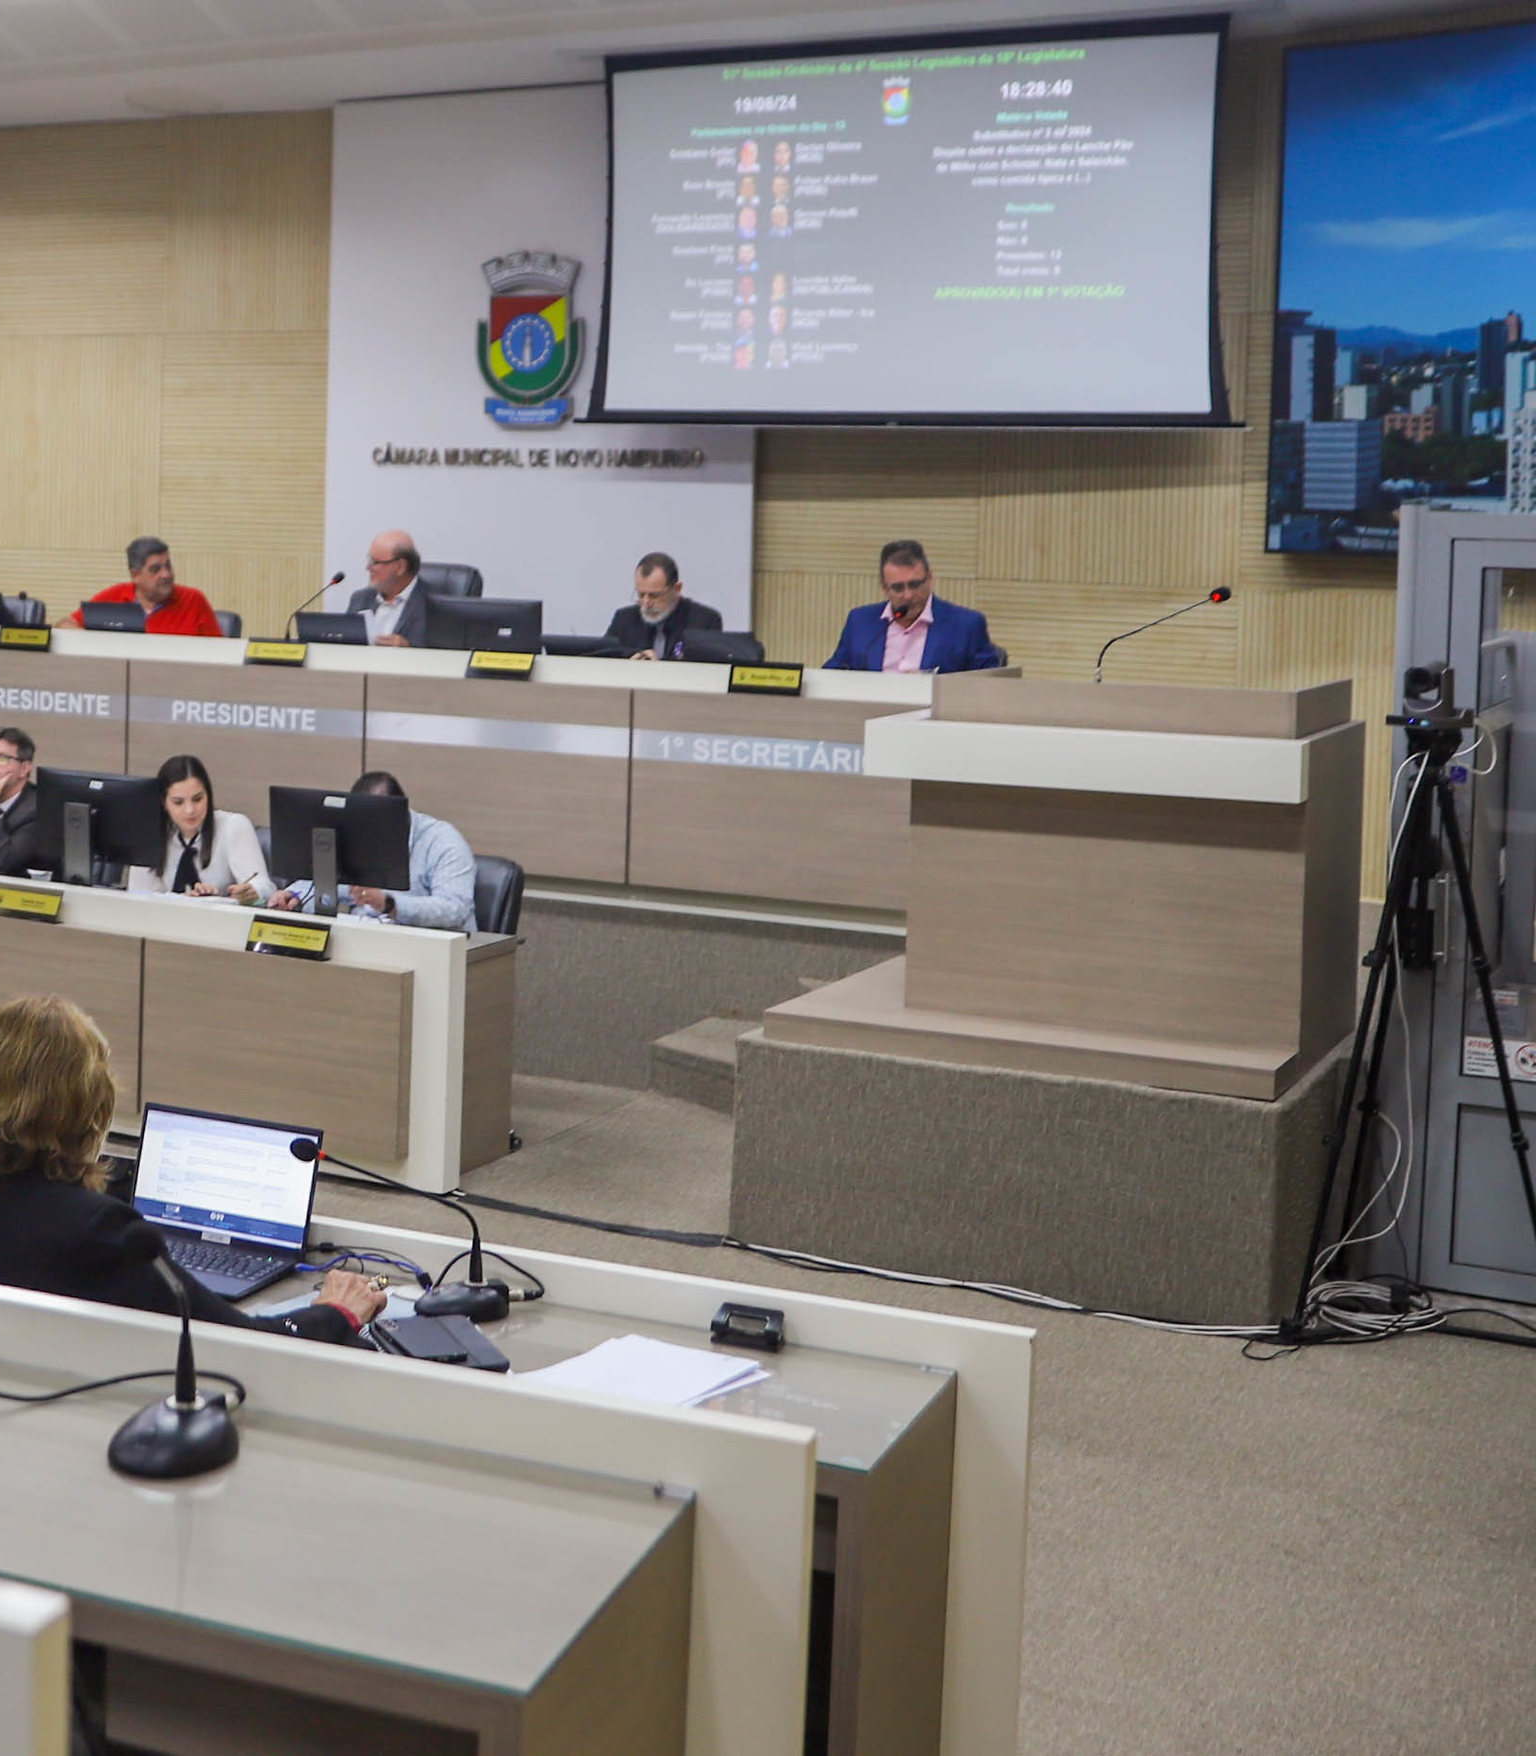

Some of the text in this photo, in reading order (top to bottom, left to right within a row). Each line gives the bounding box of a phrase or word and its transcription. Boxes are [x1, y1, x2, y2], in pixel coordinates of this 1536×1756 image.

[999, 79, 1074, 99] 18:28:40
[734, 94, 798, 113] 19/08/24
[372, 443, 705, 469] CÂMARA MUNICIPAL DE NOVO HAMBURGO
[172, 701, 316, 732] PRESIDENTE
[658, 735, 865, 773] 1º SECRETÁRI
